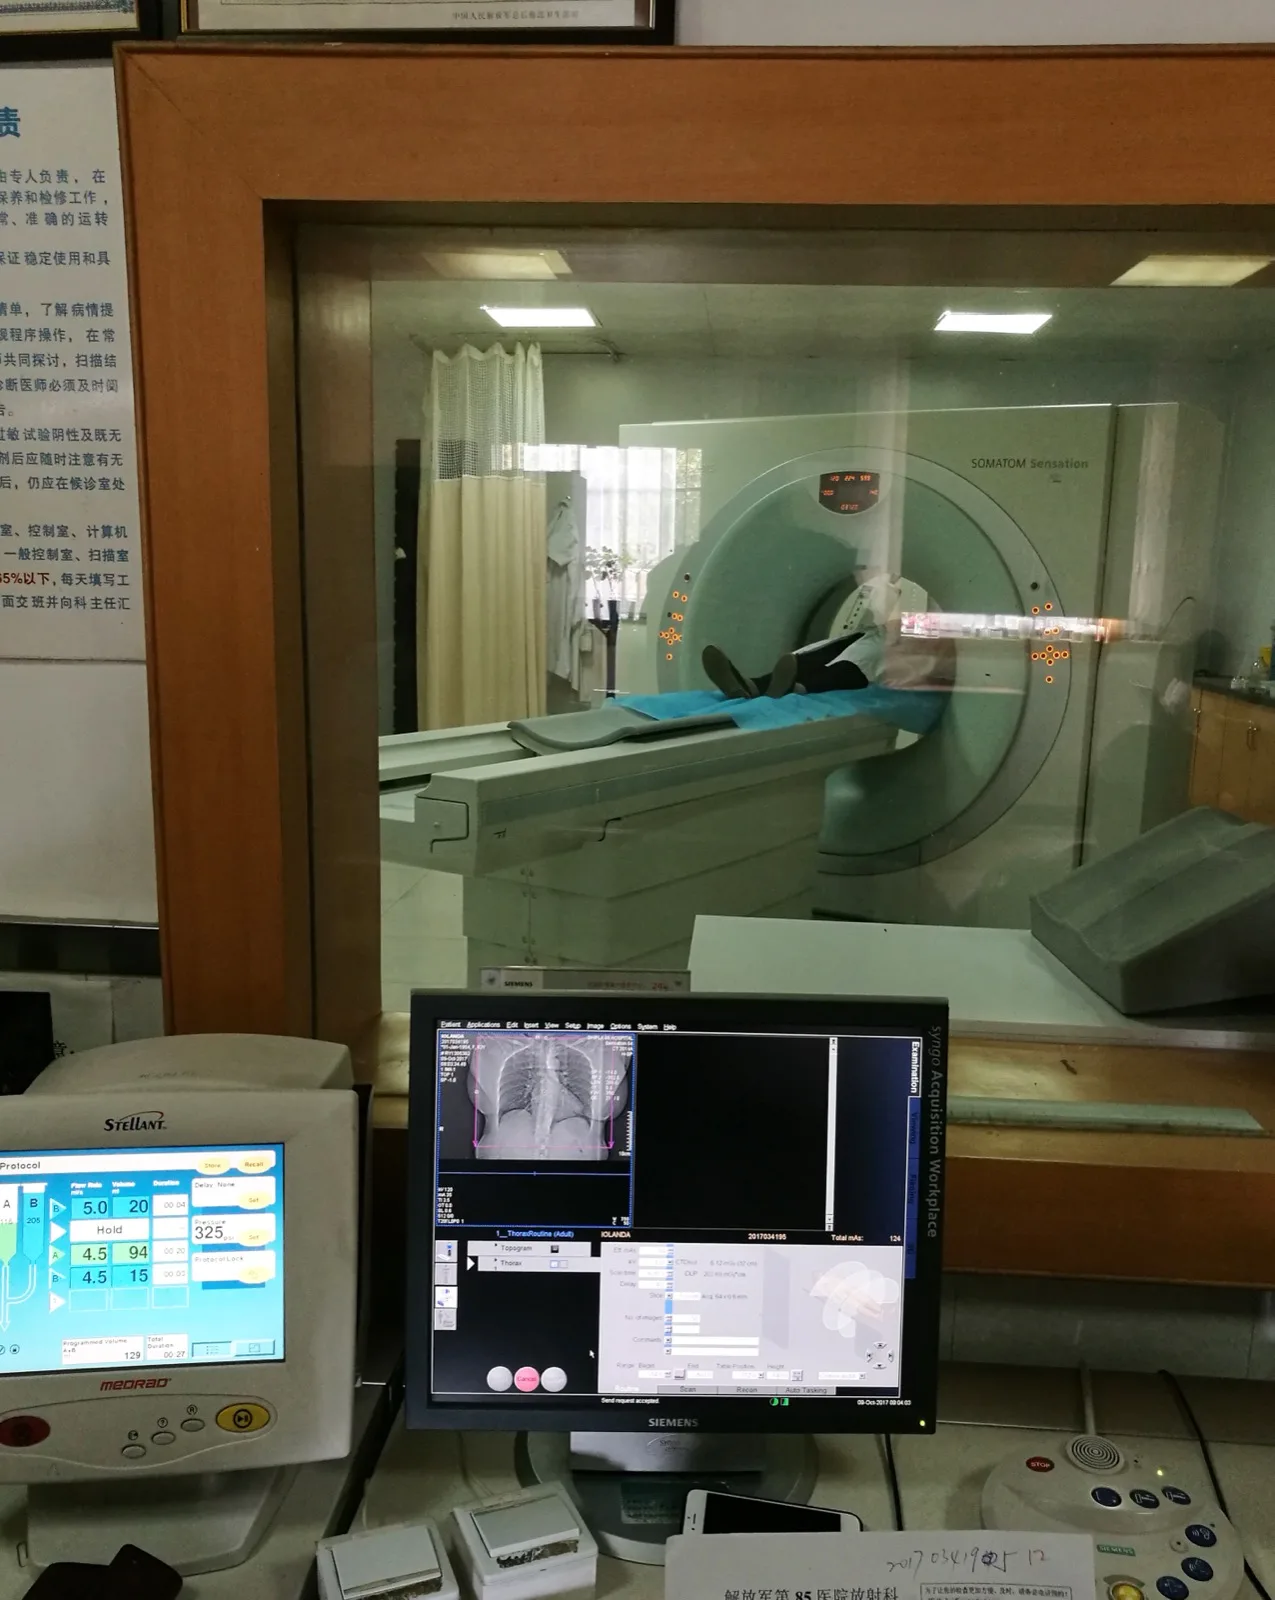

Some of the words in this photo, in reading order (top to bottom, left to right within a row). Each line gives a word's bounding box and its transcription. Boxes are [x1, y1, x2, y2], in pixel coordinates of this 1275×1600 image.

[0, 351, 117, 368] 共同探讨，扫描结
[971, 458, 1026, 468] SOMATOM
[1030, 458, 1088, 469] Sensation
[565, 1022, 581, 1030] Setup
[928, 1026, 942, 1066] syngo
[911, 1041, 920, 1094] Examination
[927, 1070, 943, 1154] Acquisition
[3, 1199, 11, 1209] A
[30, 1198, 38, 1208] B
[925, 1159, 941, 1238] Workplace
[53, 1204, 60, 1213] B
[84, 1200, 108, 1214] 5.0
[129, 1199, 149, 1213] 20
[97, 1225, 123, 1236] Hold
[195, 1225, 224, 1239] 325
[554, 1230, 574, 1238] (Adult)
[52, 1250, 59, 1259] A
[82, 1247, 107, 1261] 4.5
[129, 1245, 149, 1259] 94
[52, 1274, 59, 1283] B
[82, 1270, 107, 1284] 4.5
[130, 1268, 149, 1282] 15
[124, 1351, 141, 1360] 129
[648, 1418, 699, 1427] SIEMENS
[1030, 1461, 1051, 1469] STOP
[795, 1590, 812, 1600] 85
